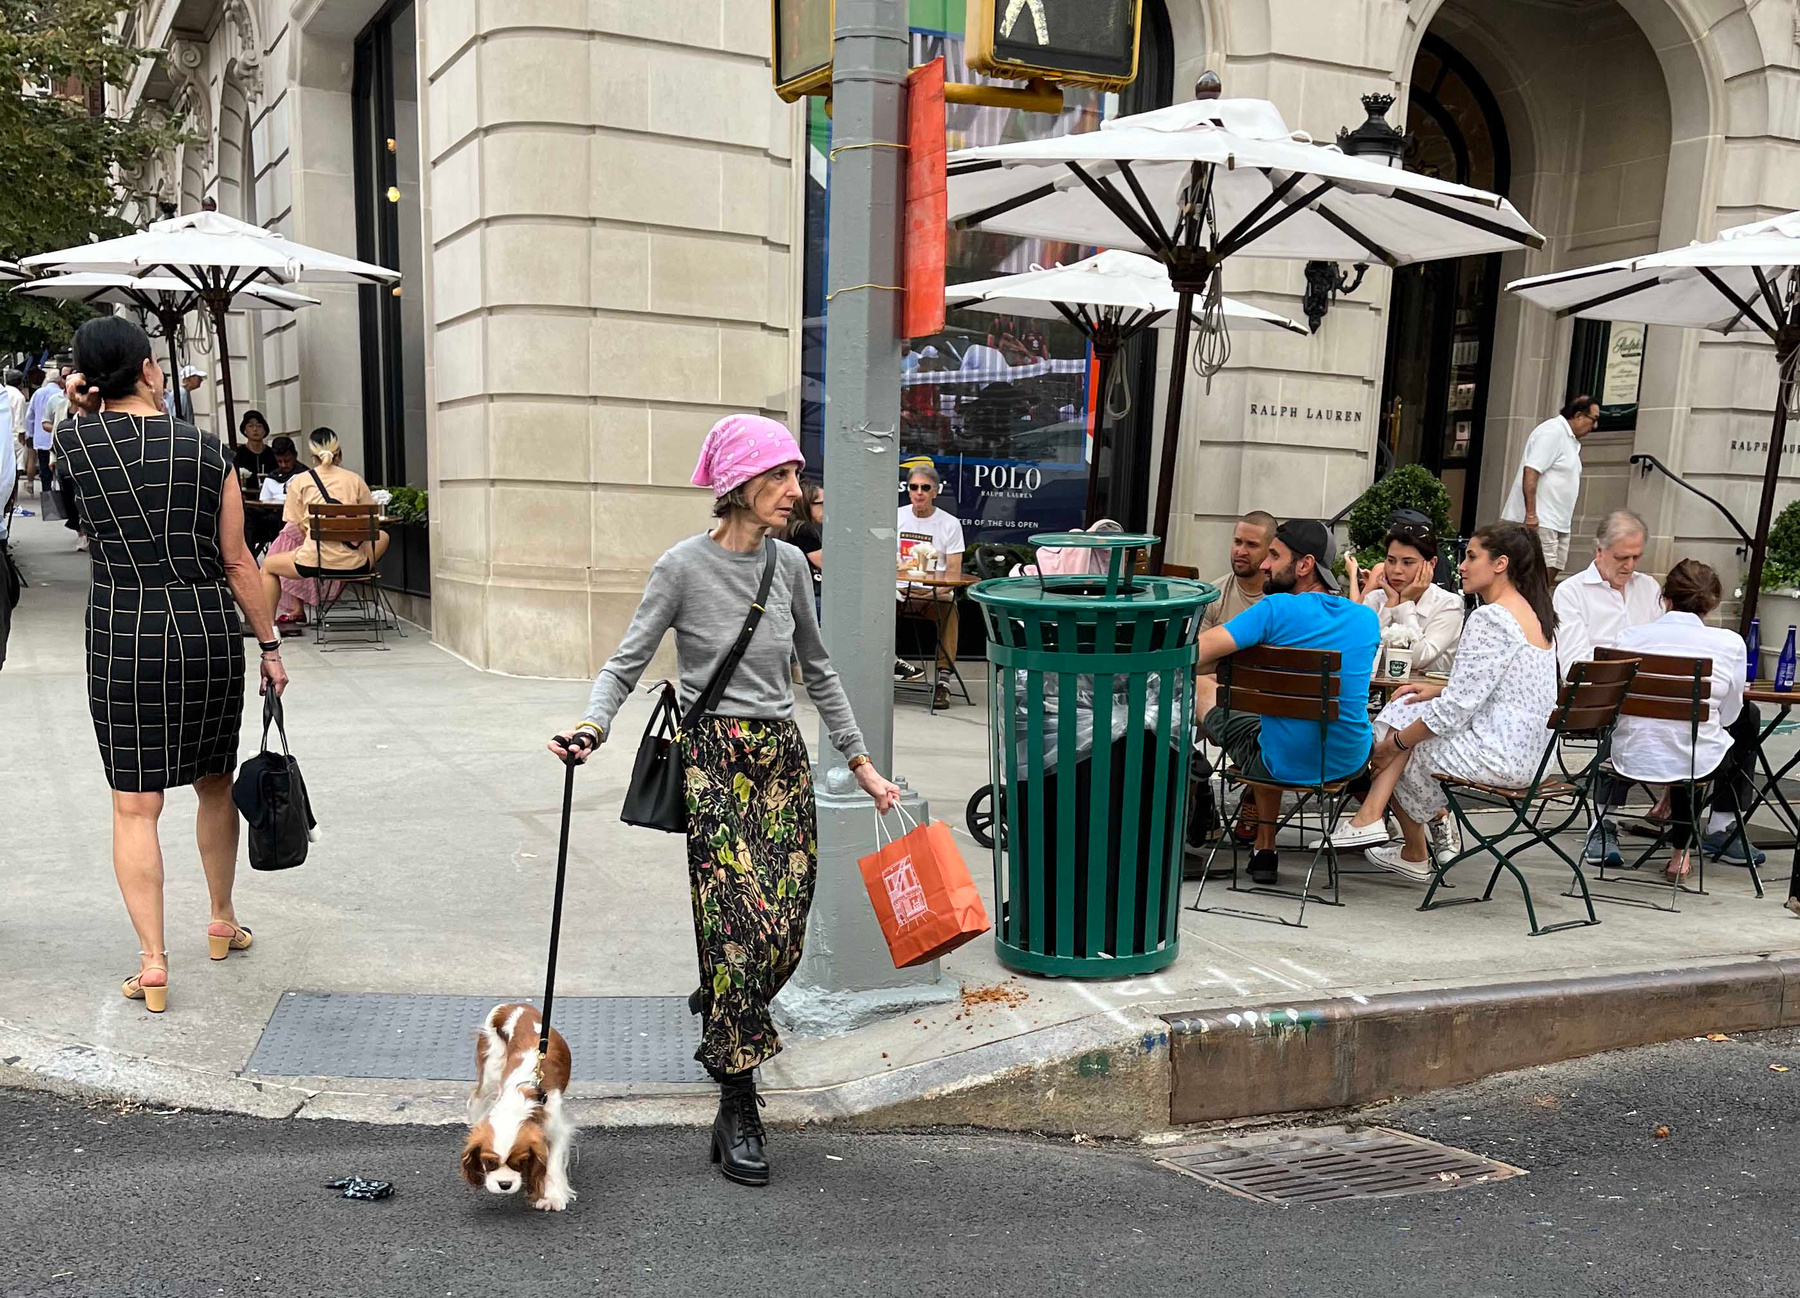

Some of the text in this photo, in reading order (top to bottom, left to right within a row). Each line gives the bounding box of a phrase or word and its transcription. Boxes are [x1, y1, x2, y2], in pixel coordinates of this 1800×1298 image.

[1250, 404, 1362, 422] RALPH LAUREN
[1731, 440, 1768, 452] RALPH
[974, 464, 1042, 491] POLO
[981, 490, 1004, 498] RALPH
[1005, 520, 1016, 528] US
[1018, 521, 1040, 529] OPEN
